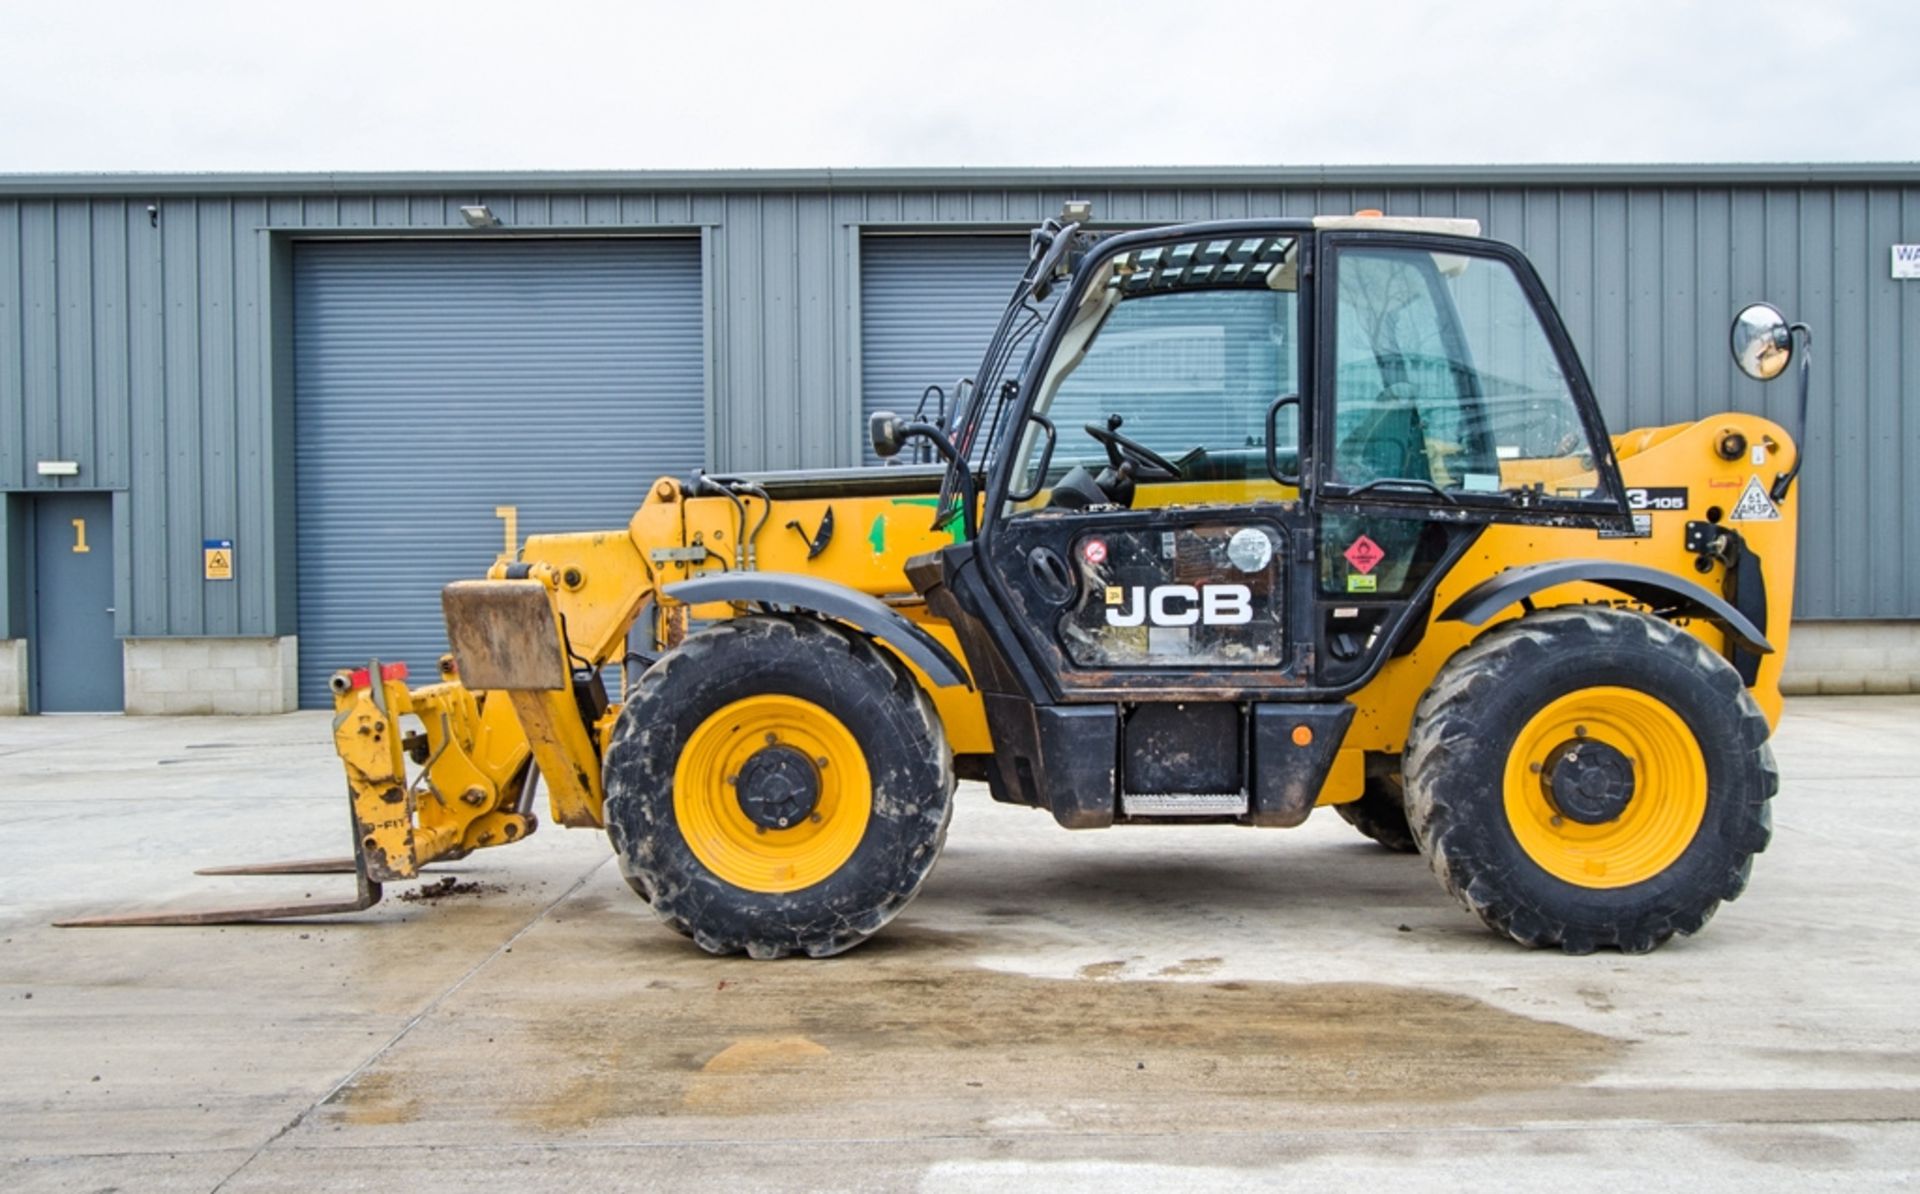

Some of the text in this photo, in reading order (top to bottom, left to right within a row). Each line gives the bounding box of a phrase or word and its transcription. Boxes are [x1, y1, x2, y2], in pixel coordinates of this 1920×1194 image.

[1626, 489, 1684, 508] 3-105
[72, 519, 89, 552] 1
[1106, 585, 1253, 627] JCB
